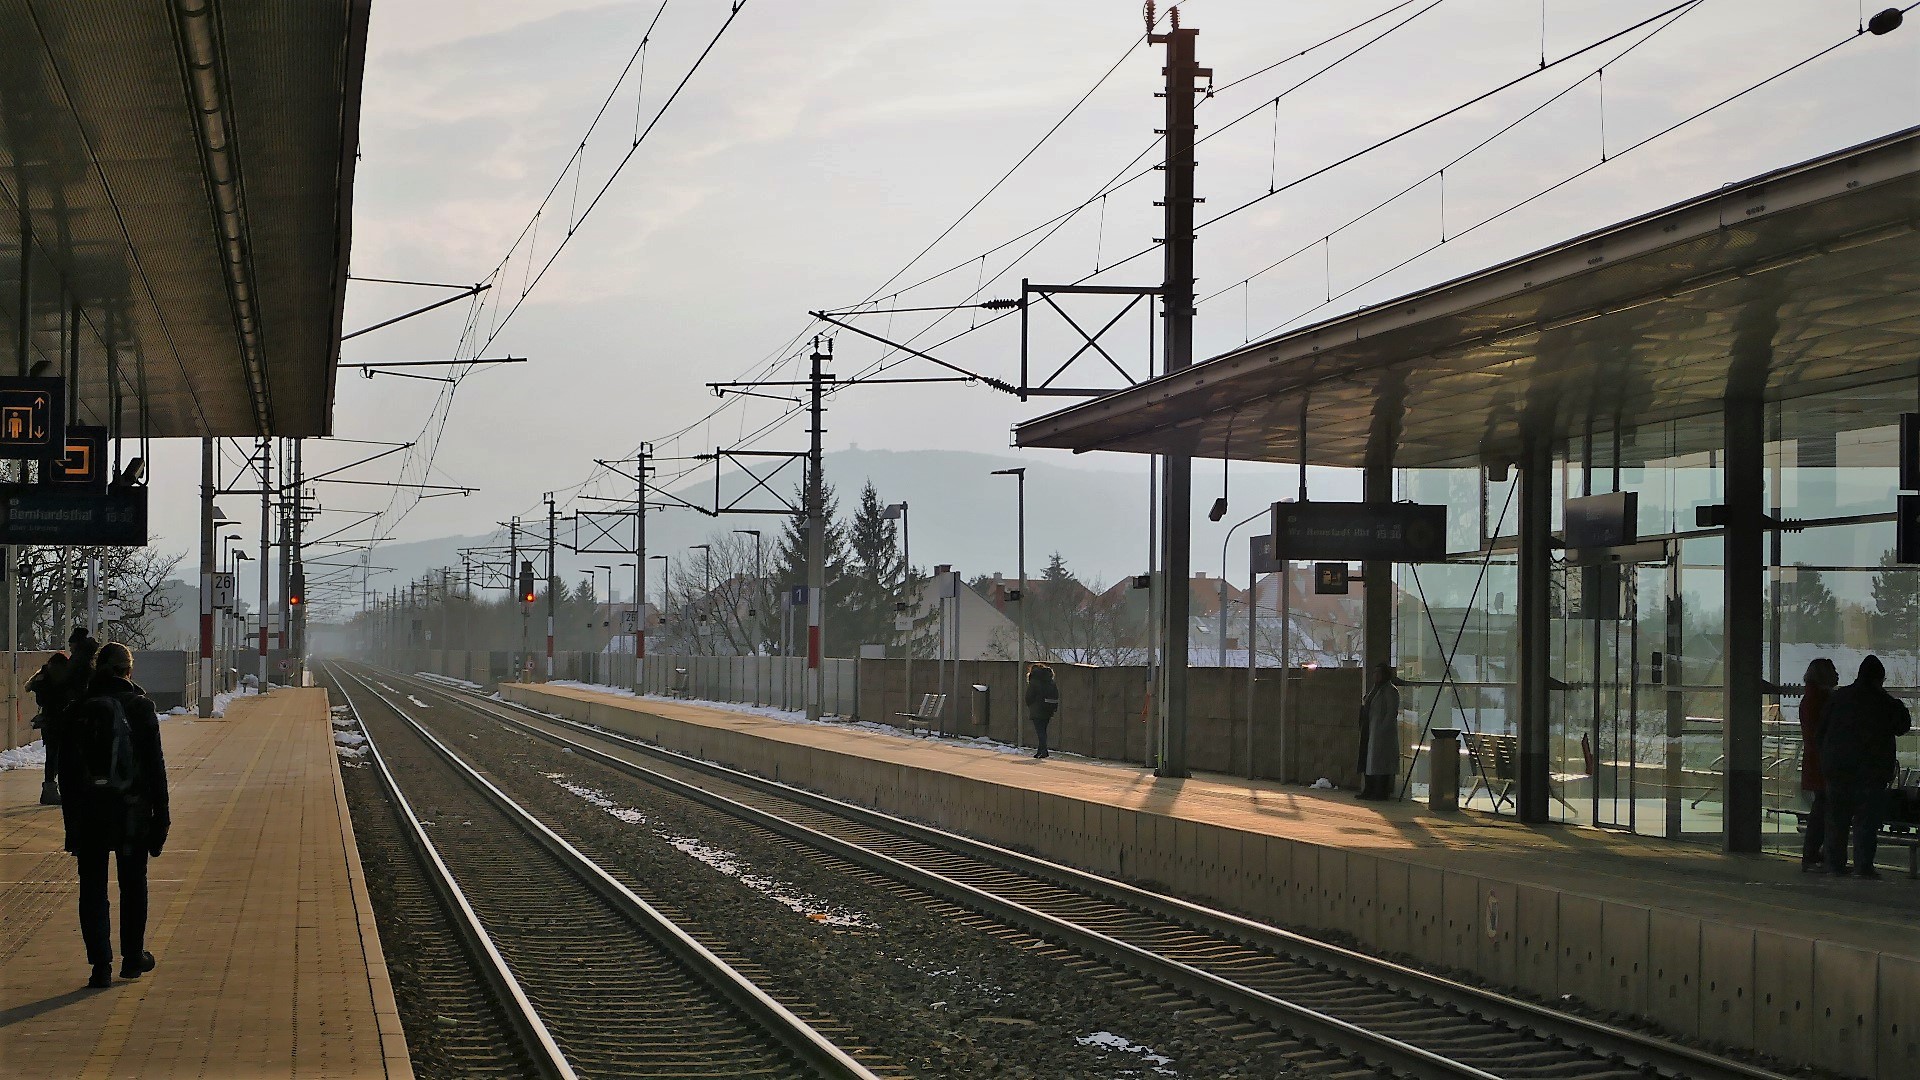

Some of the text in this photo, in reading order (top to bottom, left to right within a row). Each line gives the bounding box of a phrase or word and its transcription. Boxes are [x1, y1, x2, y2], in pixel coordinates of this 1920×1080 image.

[215, 575, 231, 589] 26
[220, 591, 226, 605] 1
[796, 588, 802, 602] 1
